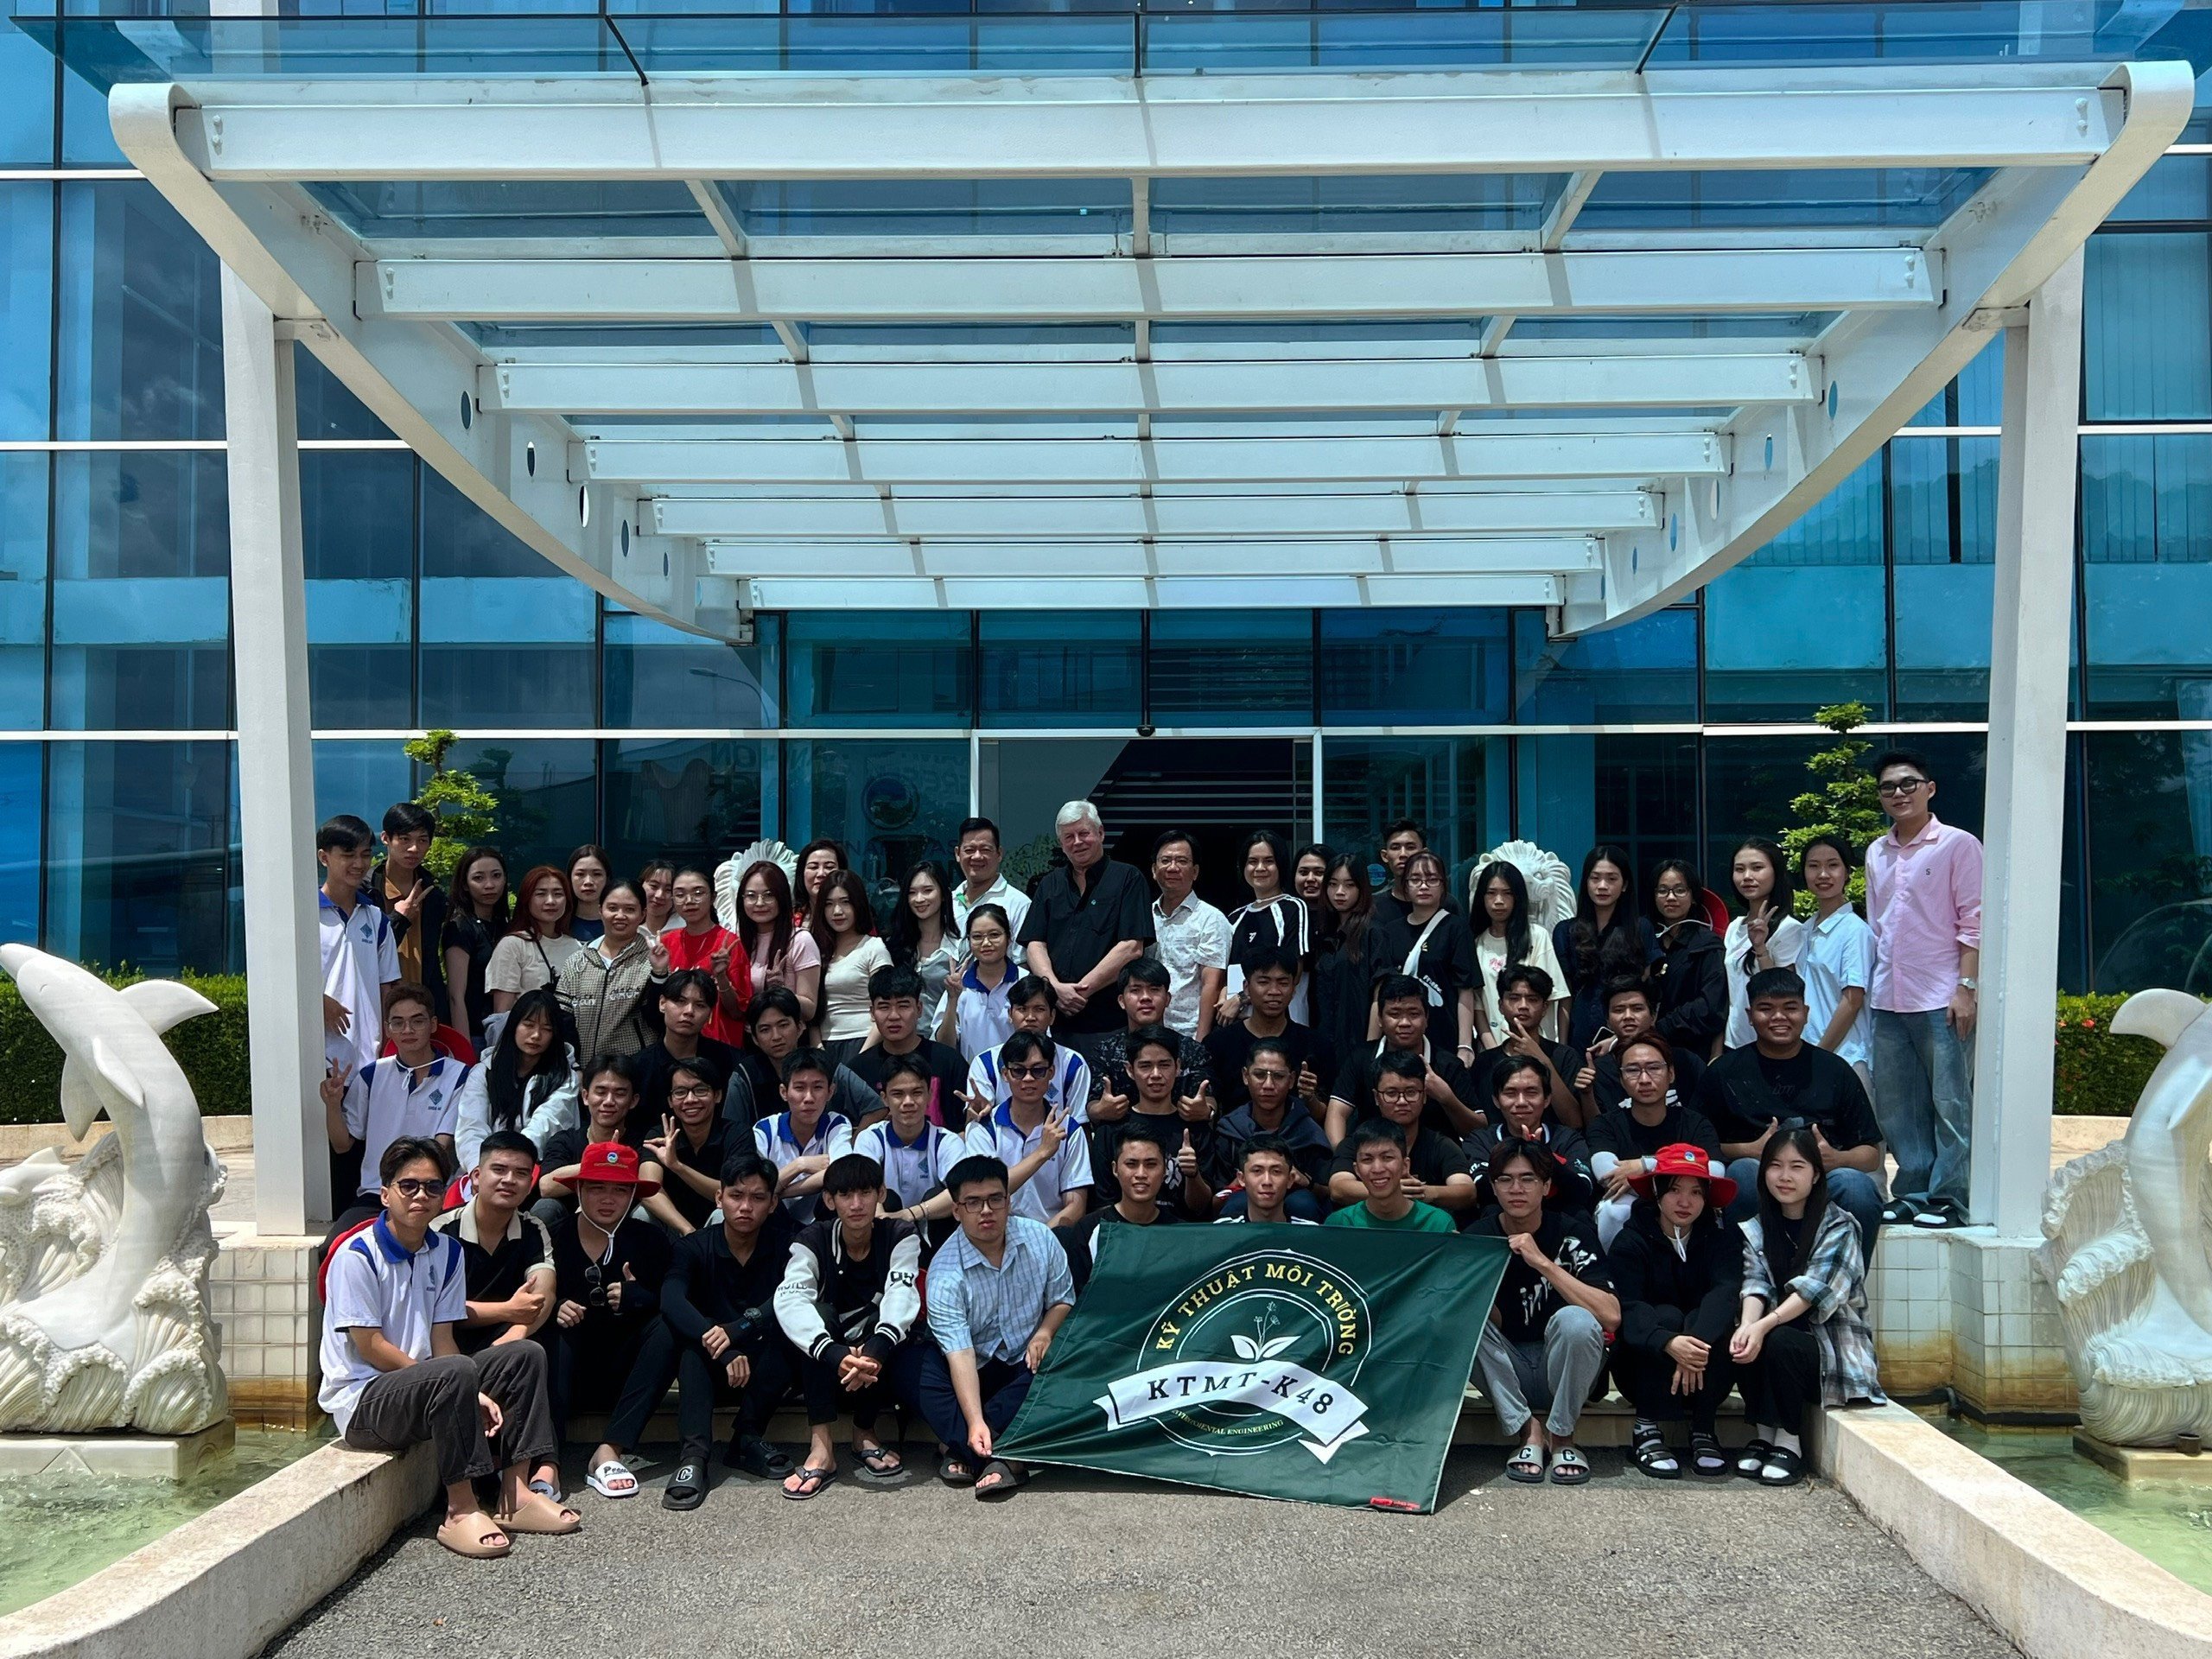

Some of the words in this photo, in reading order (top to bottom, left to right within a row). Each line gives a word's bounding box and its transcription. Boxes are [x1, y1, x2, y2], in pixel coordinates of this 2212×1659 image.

[1155, 1320, 1181, 1350] KỸ
[1177, 1265, 1255, 1318] THUẬT
[1264, 1262, 1314, 1287] MÔI
[1227, 1419, 1284, 1435] ENGINEERING
